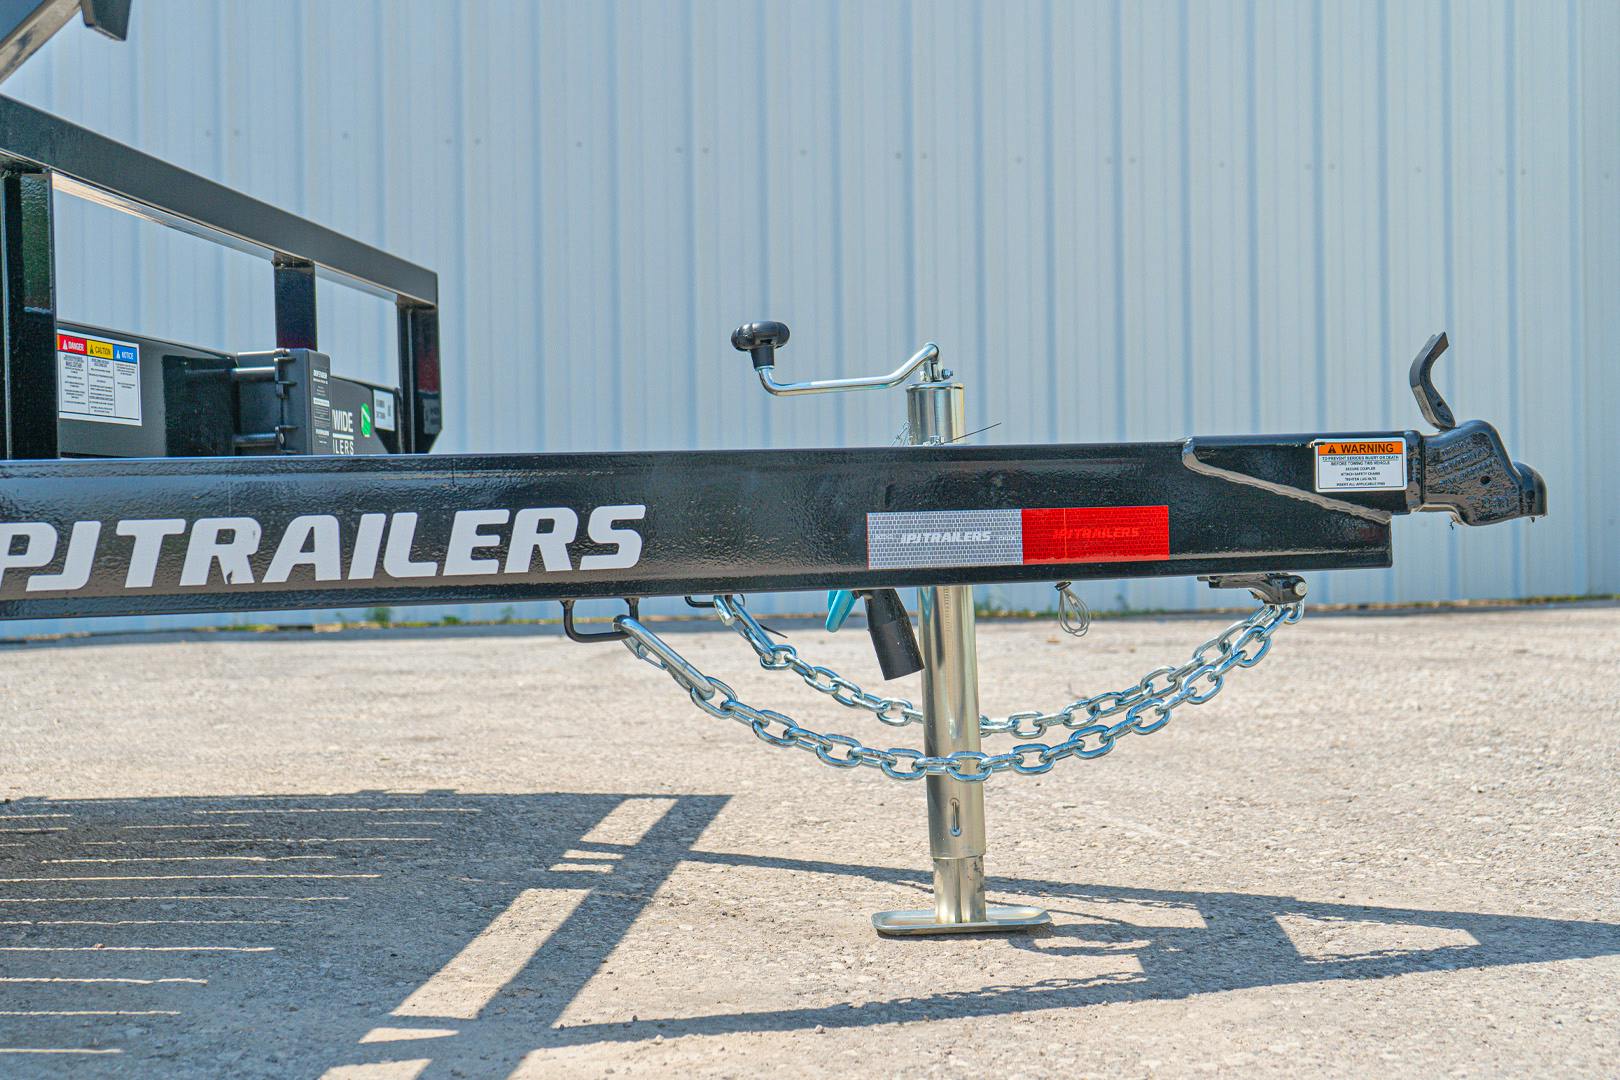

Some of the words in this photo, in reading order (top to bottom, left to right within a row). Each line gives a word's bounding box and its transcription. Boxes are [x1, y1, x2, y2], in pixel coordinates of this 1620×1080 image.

[68, 341, 85, 351] DANGER
[94, 346, 111, 355] CAUTION
[121, 351, 134, 360] NOTICE
[1340, 443, 1394, 454] WARNING
[922, 530, 992, 543] TRAILERS
[0, 519, 102, 593] PJ
[115, 503, 647, 589] TRAILERS
